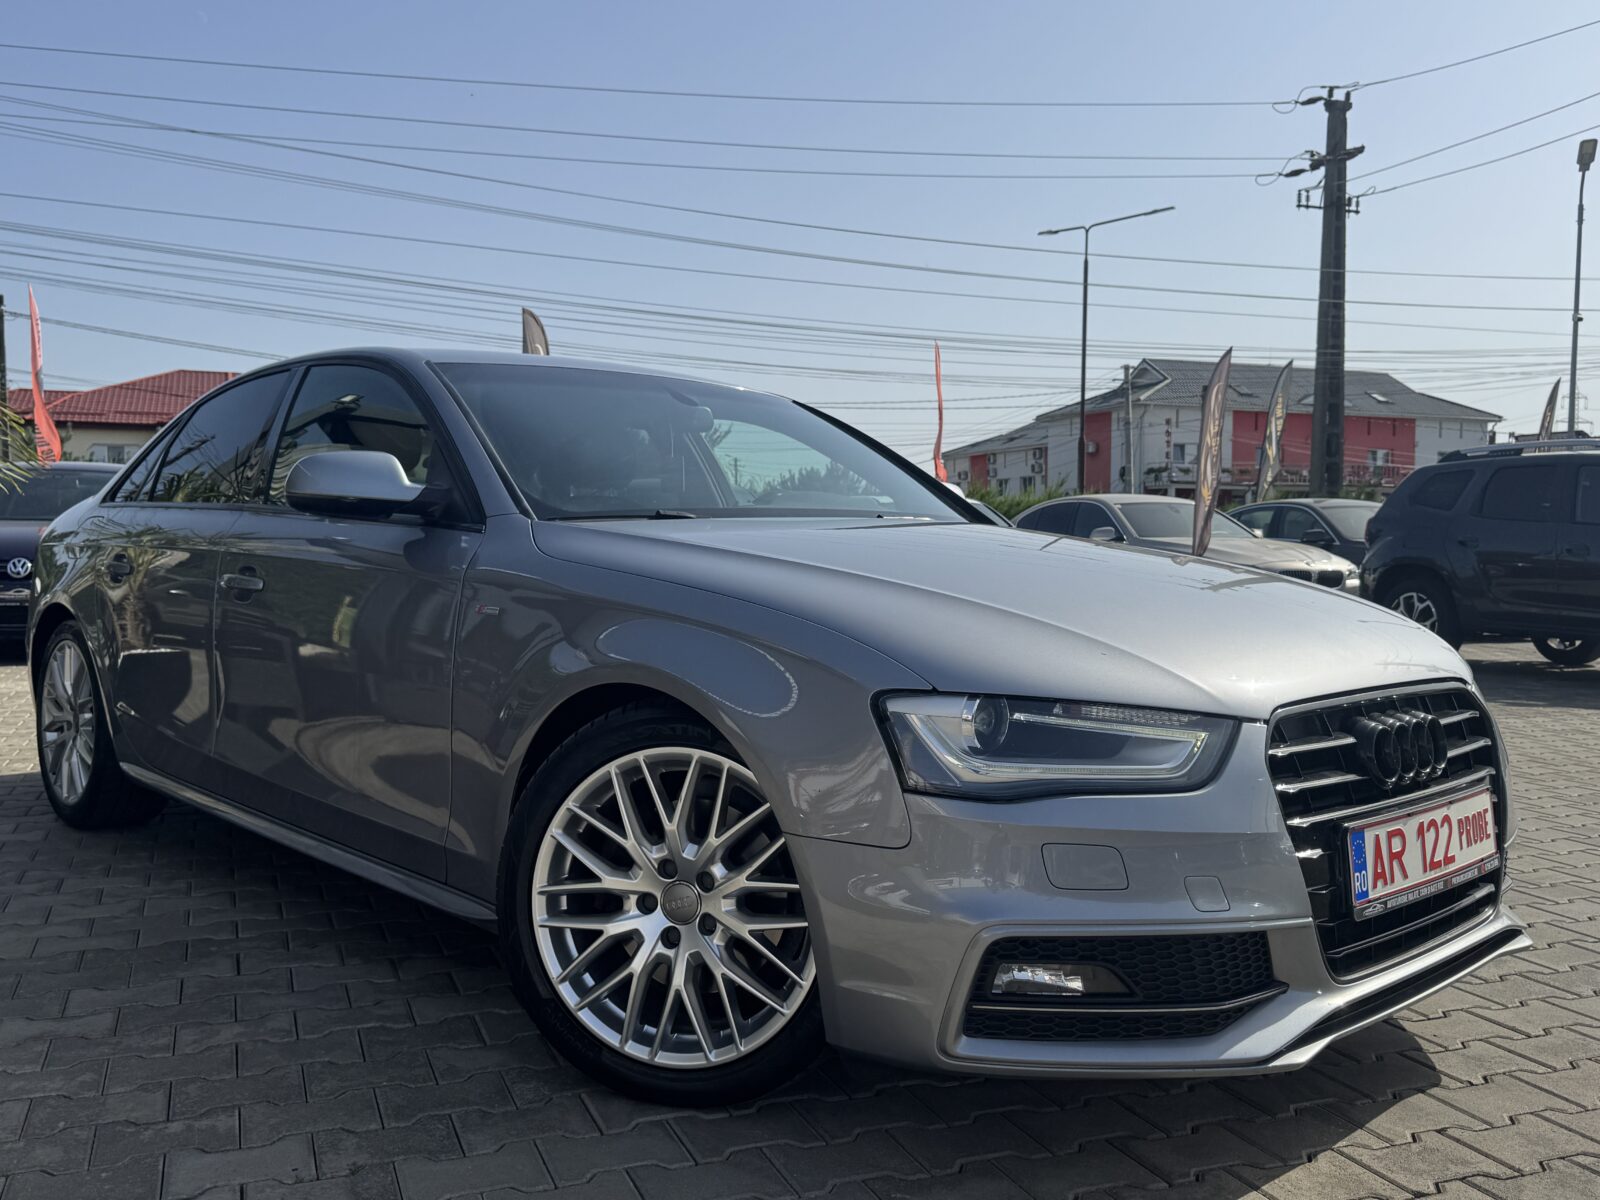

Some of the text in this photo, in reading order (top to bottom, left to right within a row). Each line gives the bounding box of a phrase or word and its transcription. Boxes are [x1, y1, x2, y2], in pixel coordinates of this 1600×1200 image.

[1372, 808, 1491, 890] AR 122 PROBE
[1354, 871, 1368, 894] RO
